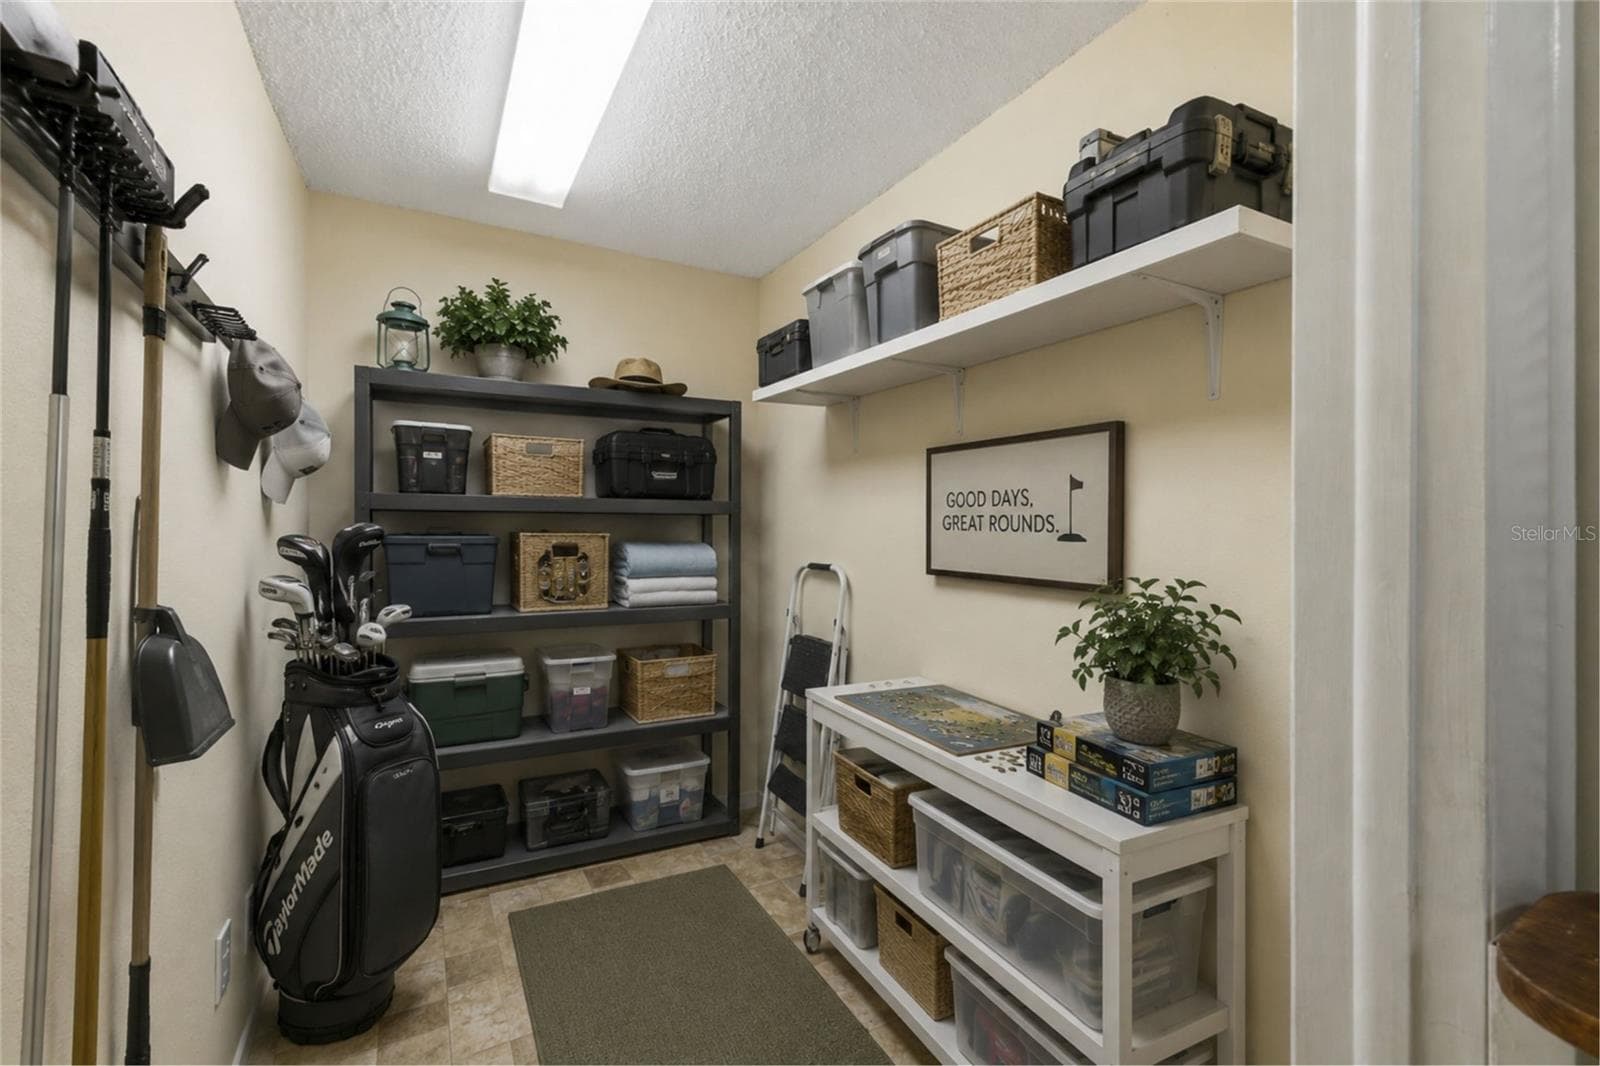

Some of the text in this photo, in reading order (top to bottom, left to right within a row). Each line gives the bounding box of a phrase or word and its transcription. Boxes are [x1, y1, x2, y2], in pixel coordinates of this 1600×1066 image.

[946, 488, 1034, 508] GOOD DAYS,
[942, 514, 1060, 533] GREAT ROUNDS.
[263, 828, 335, 956] TaylorMade
